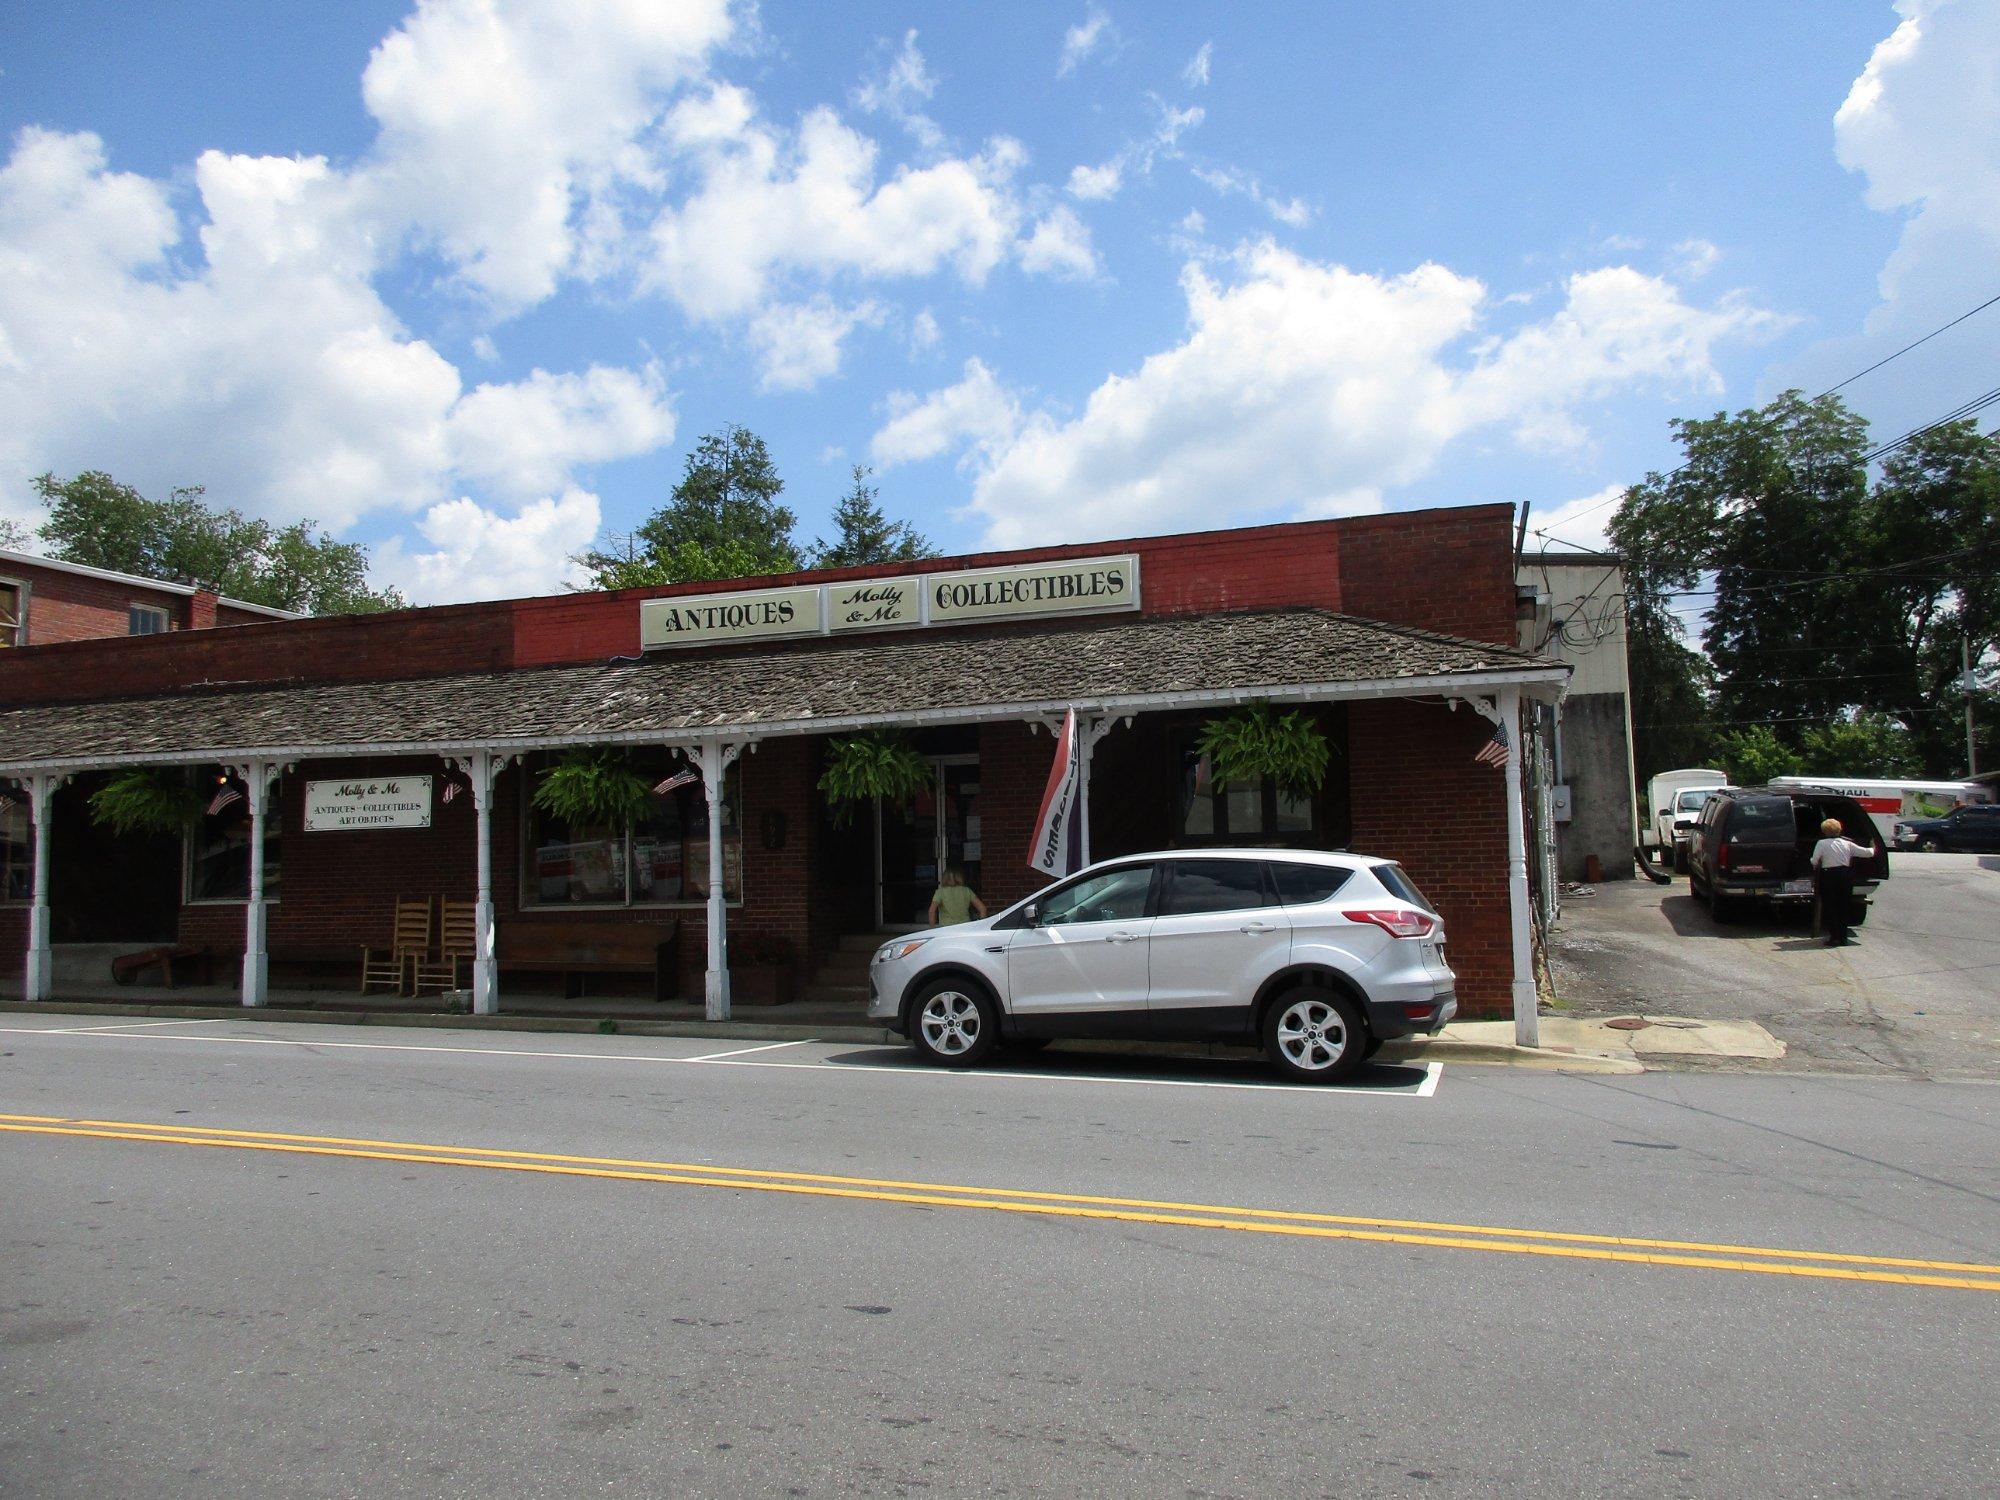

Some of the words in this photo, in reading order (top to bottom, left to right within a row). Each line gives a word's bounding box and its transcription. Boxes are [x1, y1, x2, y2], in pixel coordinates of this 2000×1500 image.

[842, 587, 903, 605] Molly
[936, 570, 1124, 609] COLLECTIBLES
[665, 600, 794, 632] ANTIQUES
[846, 611, 864, 622] &
[863, 606, 901, 622] Me
[335, 784, 366, 800] Molly
[368, 784, 378, 794] &
[381, 783, 400, 794] Me
[1837, 789, 1870, 797] HAUL
[314, 805, 355, 814] ANTIQUES
[363, 803, 421, 812] COLLECTIBLES
[339, 816, 356, 825] ART
[358, 815, 394, 823] OBJECTS
